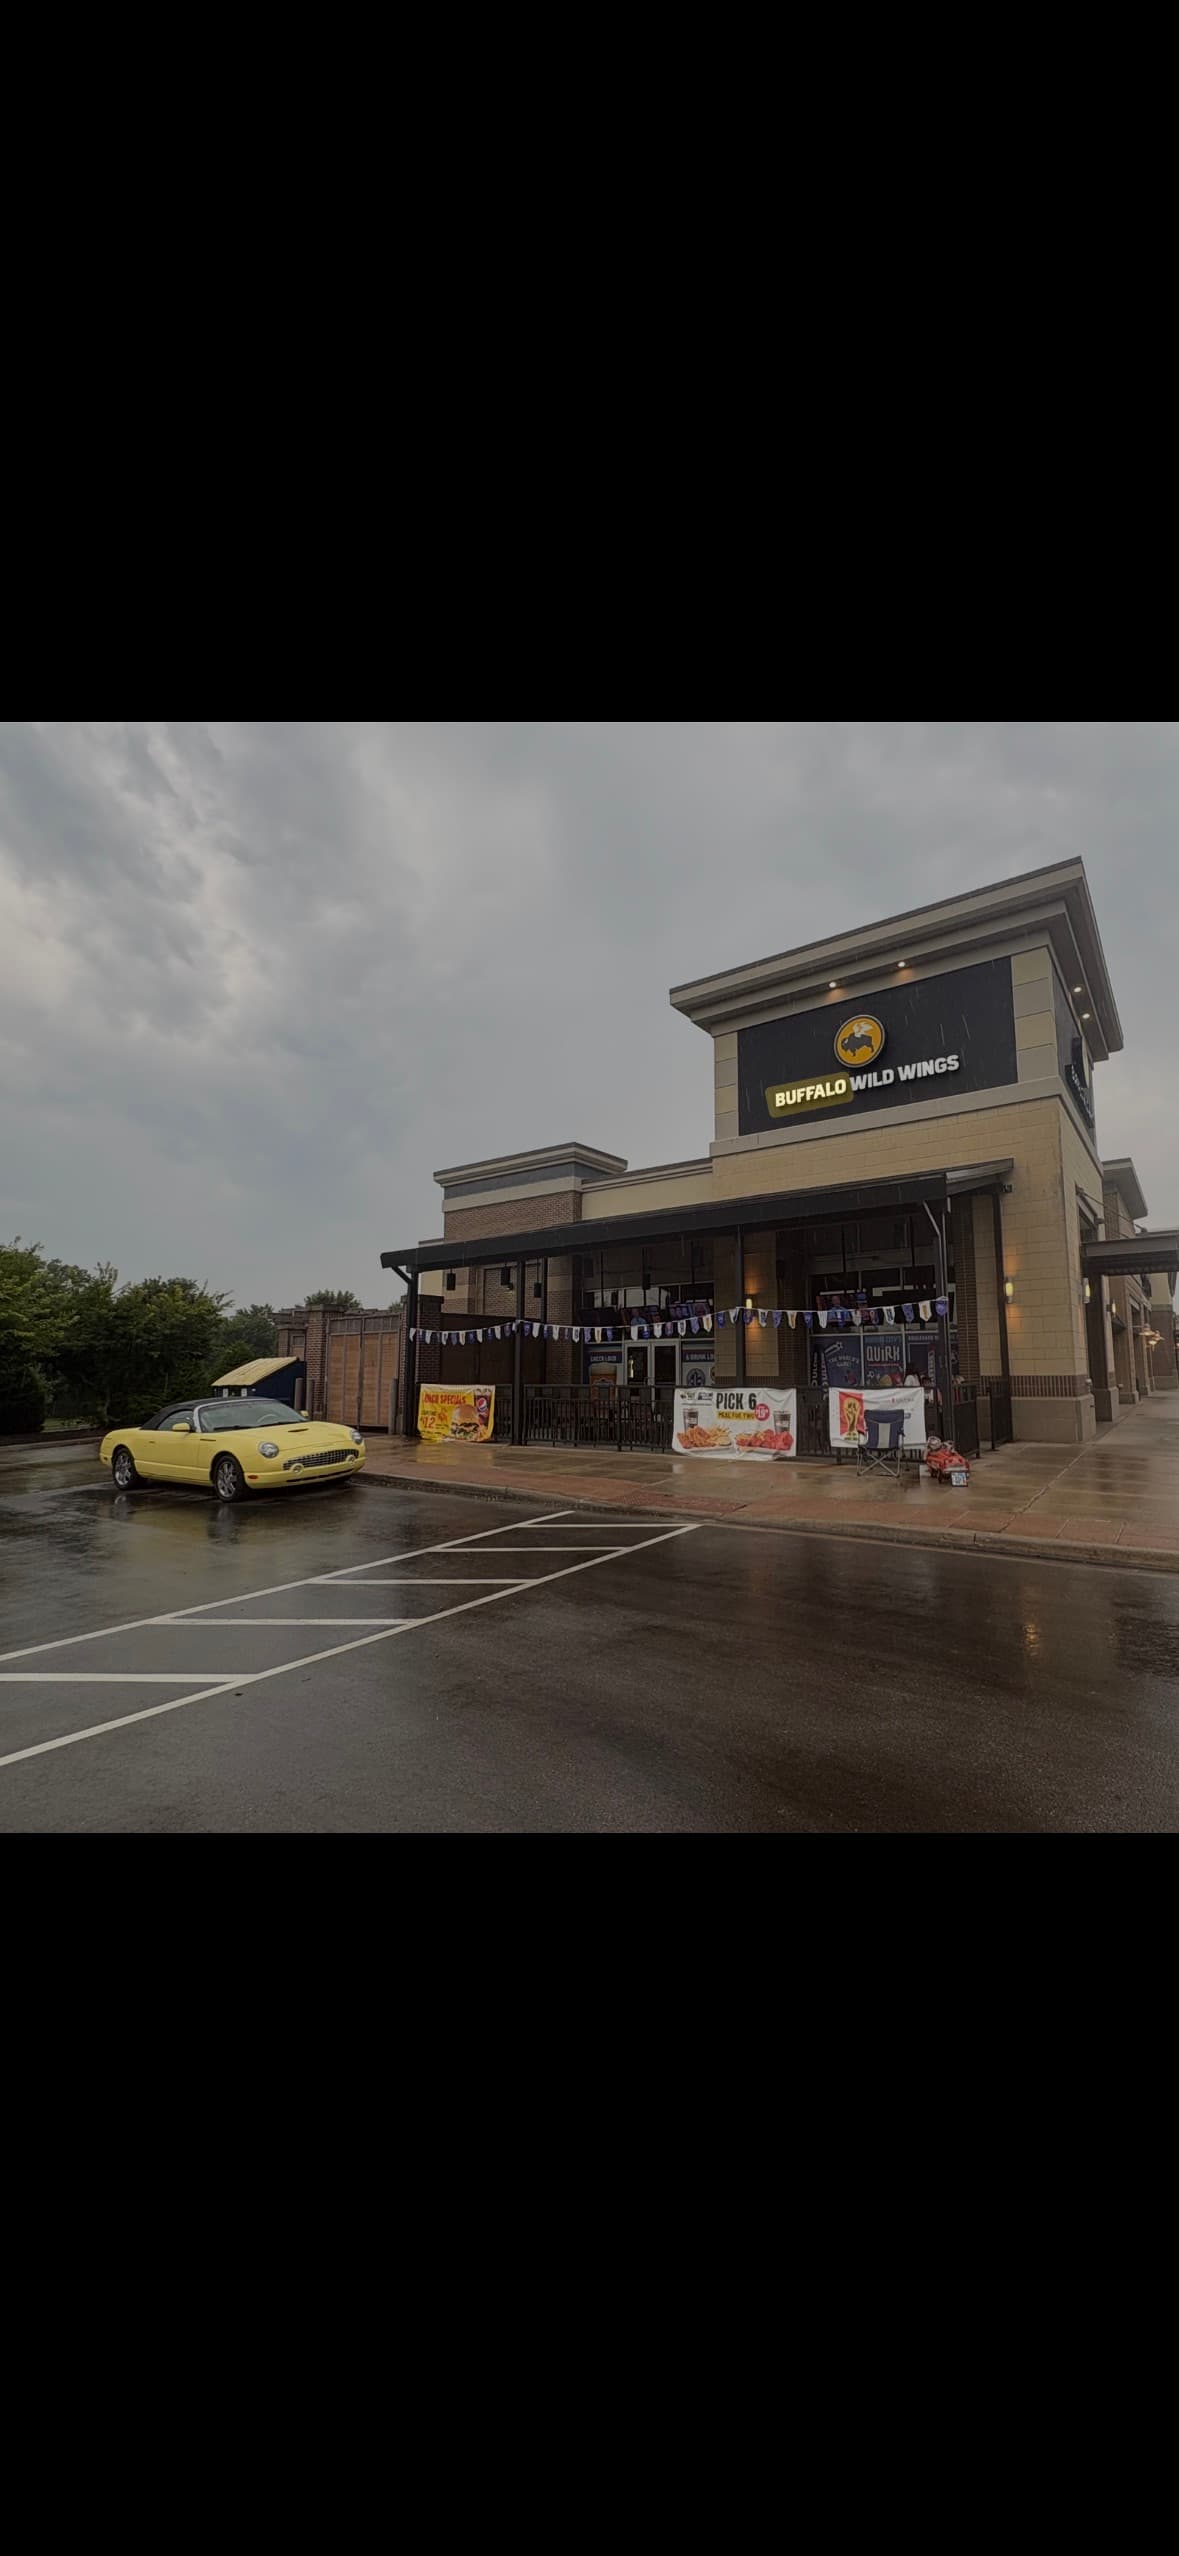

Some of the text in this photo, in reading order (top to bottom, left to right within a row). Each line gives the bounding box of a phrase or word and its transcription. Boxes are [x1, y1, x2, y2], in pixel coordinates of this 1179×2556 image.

[775, 1054, 960, 1107] BUFFALO WILD WINGS
[440, 1394, 466, 1405] SPECIALS
[716, 1392, 744, 1410] PICK
[748, 1392, 757, 1410] 6
